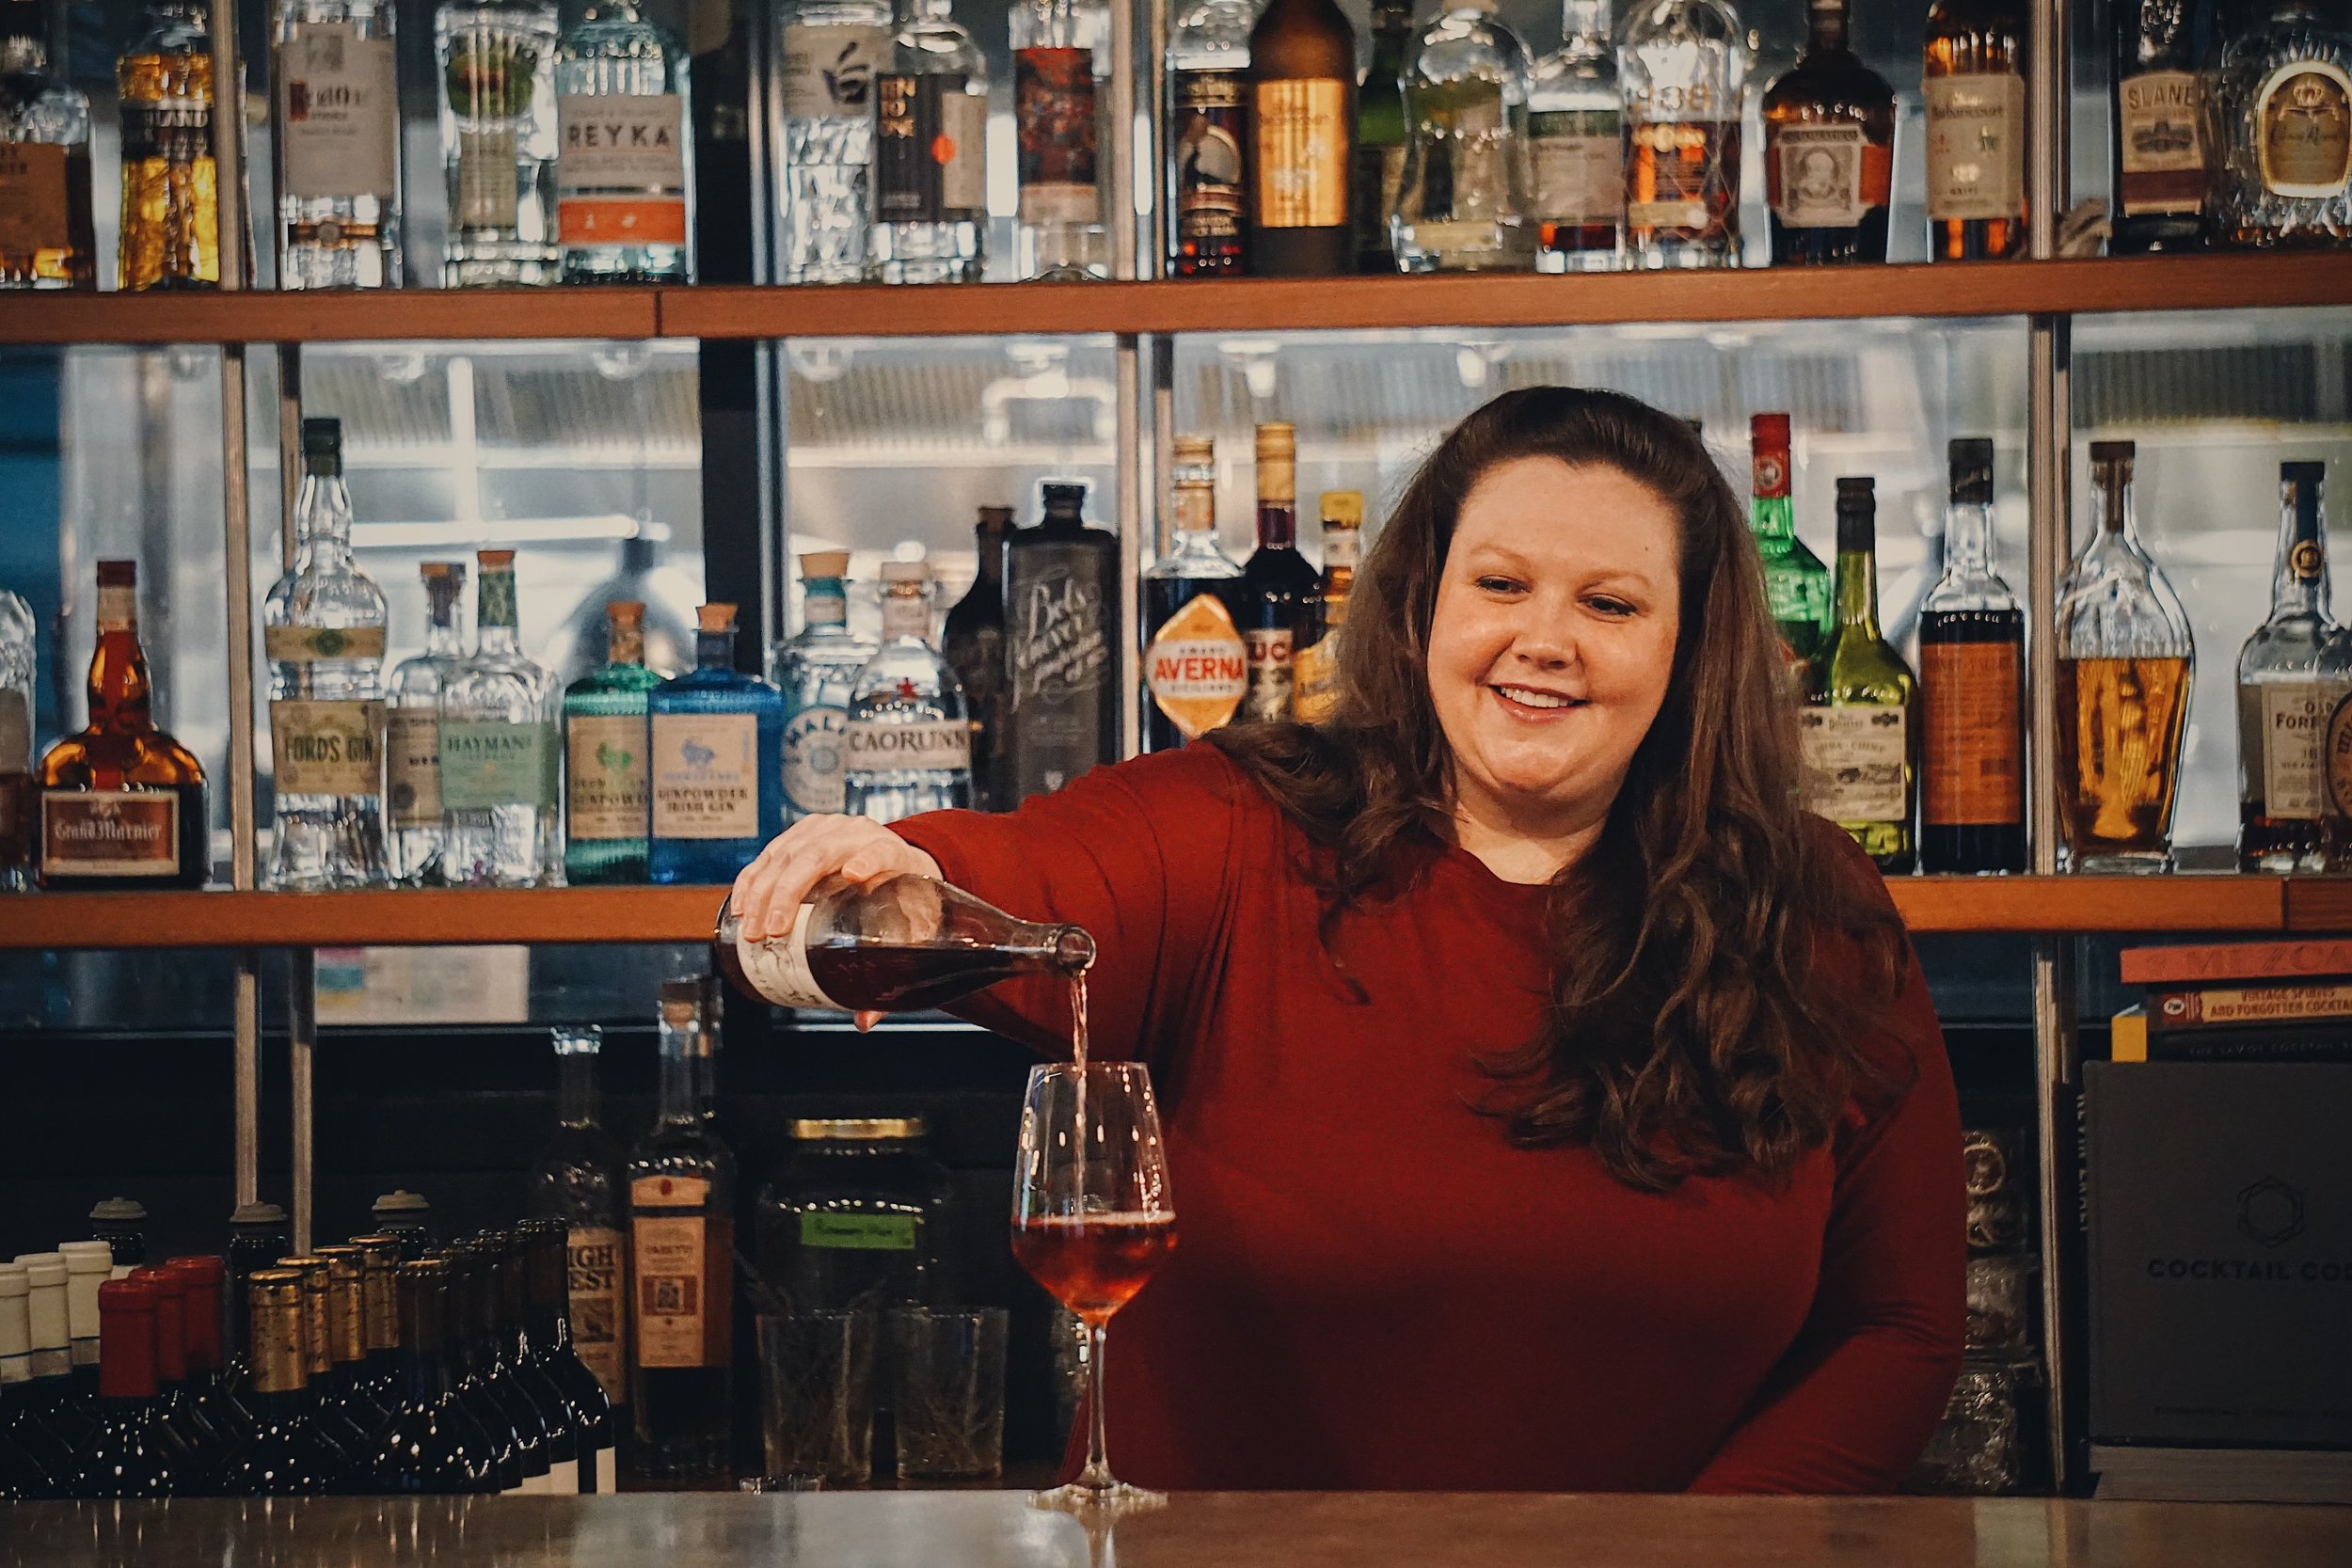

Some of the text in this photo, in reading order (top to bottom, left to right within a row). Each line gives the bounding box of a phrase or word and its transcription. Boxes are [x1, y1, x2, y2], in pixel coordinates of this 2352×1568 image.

[2128, 86, 2193, 109] SLANE
[567, 123, 672, 147] REYKA
[1155, 657, 1245, 681] AVERNA
[284, 735, 340, 763] FORDS
[849, 729, 966, 752] CAORUNN
[2211, 1004, 2234, 1017] AND
[2148, 1259, 2290, 1281] COCKTAIL
